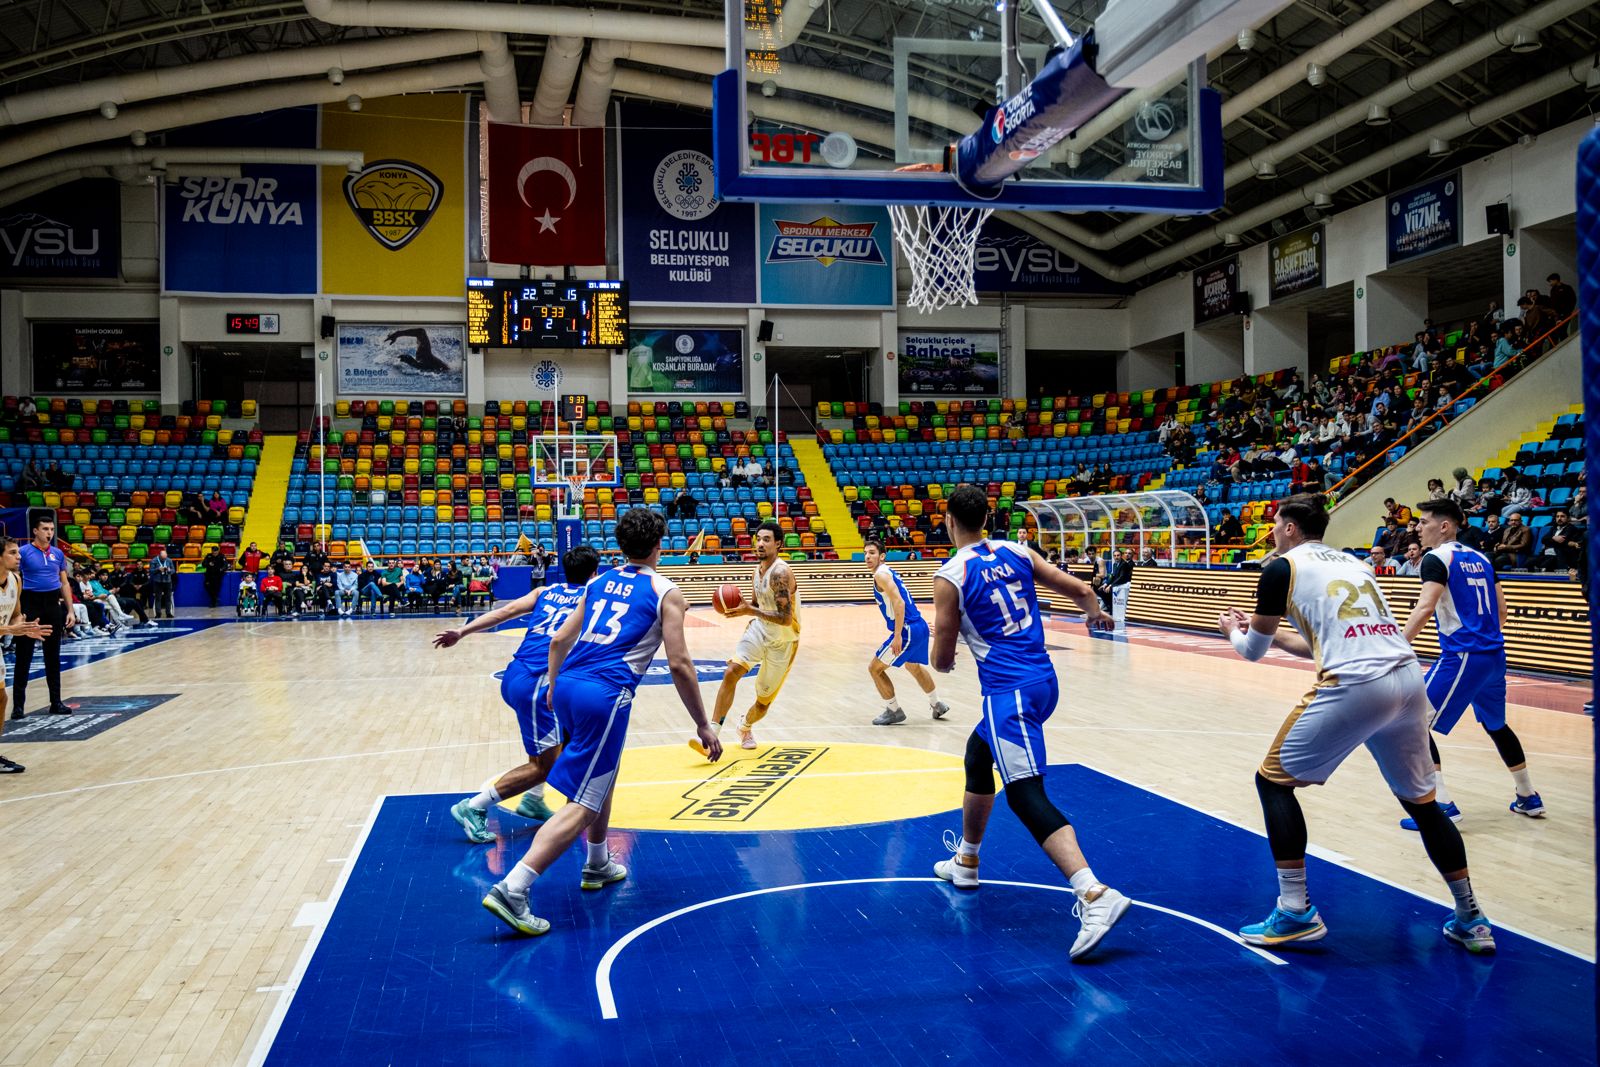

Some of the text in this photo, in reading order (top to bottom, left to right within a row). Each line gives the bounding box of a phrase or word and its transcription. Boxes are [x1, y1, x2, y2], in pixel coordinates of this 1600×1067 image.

[379, 171, 408, 179] KONYA
[180, 176, 278, 203] SPOR
[182, 195, 303, 225] KONYA
[681, 210, 697, 218] 1997
[372, 210, 417, 226] BBSK
[783, 227, 823, 236] SPORUN
[649, 229, 729, 251] SELÇUKLU
[777, 238, 873, 257] SELÇUKLU
[669, 269, 712, 282] KULÜBÜ
[523, 288, 537, 300] 22
[567, 289, 577, 300] 15
[523, 317, 531, 331] 0
[545, 318, 553, 329] 2
[572, 318, 576, 331] 1
[906, 336, 966, 346] Selçuklu Çiçek
[906, 343, 976, 358] Bahçesi
[652, 362, 687, 373] KOŞANLAR
[575, 405, 584, 419] 9
[981, 562, 1016, 584] KARA
[604, 580, 634, 600] BAŞ
[1466, 577, 1491, 615] 77
[1327, 579, 1388, 621] 21
[989, 580, 1034, 637] 15
[531, 604, 575, 638] 20
[580, 598, 630, 645] 13
